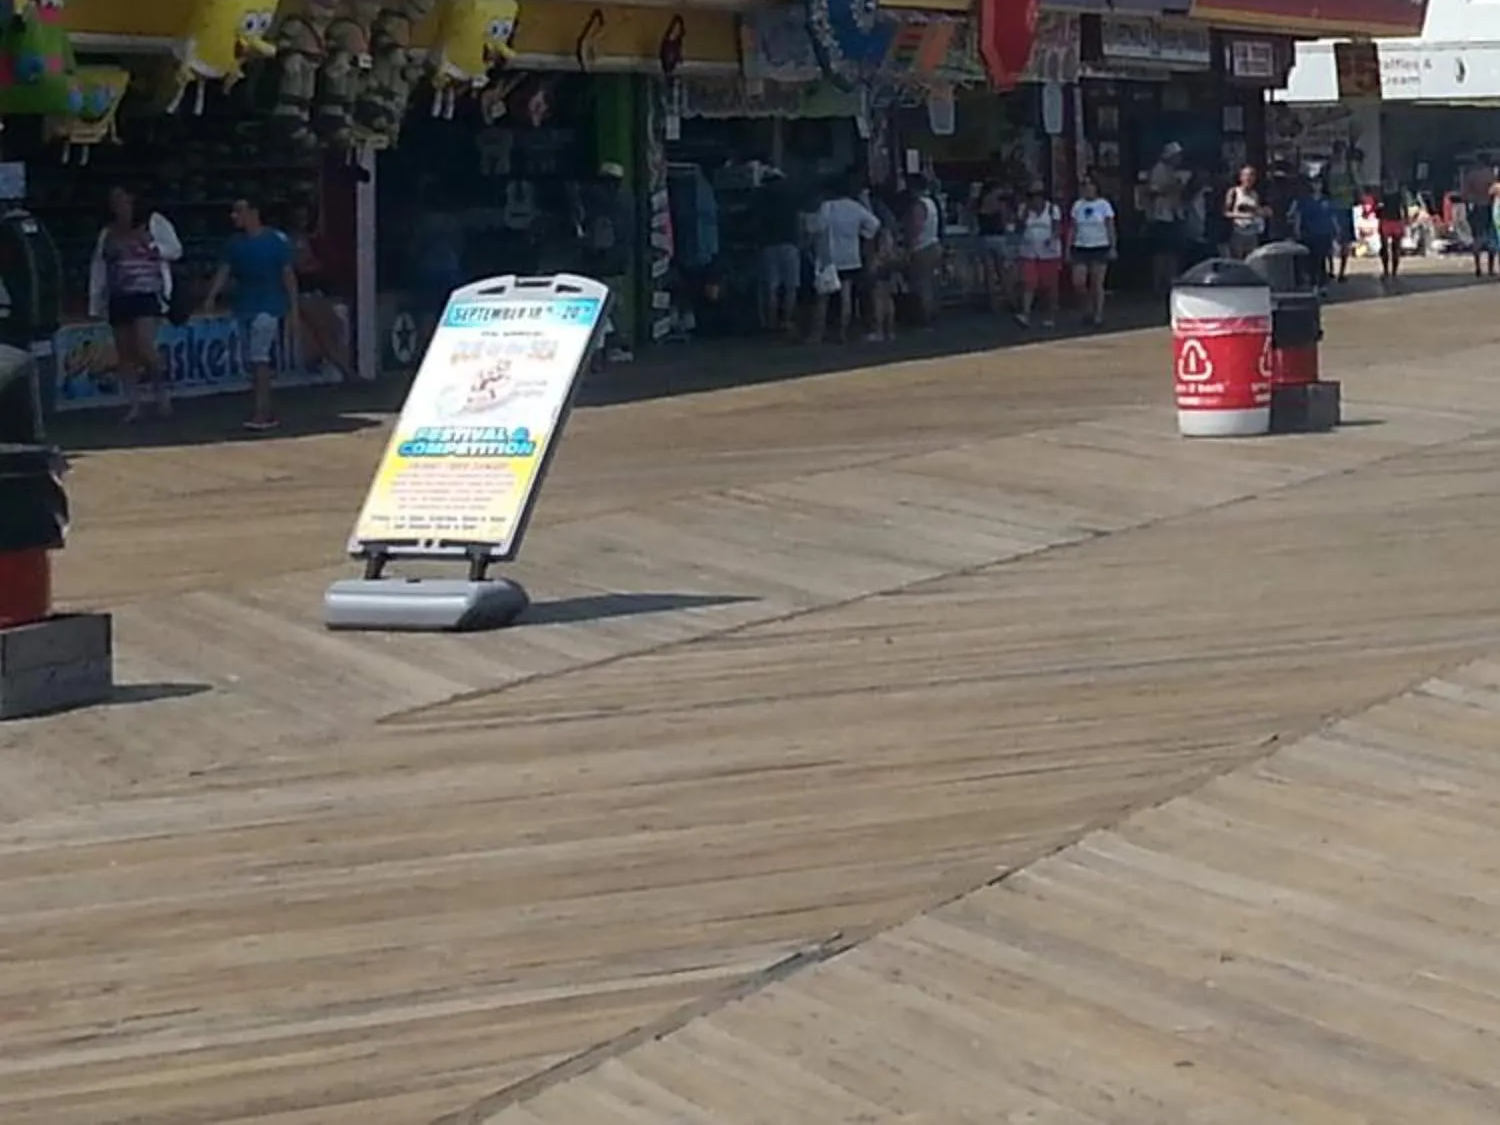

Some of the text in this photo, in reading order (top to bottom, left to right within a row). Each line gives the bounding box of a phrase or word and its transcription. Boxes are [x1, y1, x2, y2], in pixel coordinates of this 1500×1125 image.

[1382, 58, 1419, 72] affles
[454, 304, 526, 322] SEPTEMBER
[415, 427, 508, 443] FESTIVAL
[399, 441, 536, 457] COMPETITION
